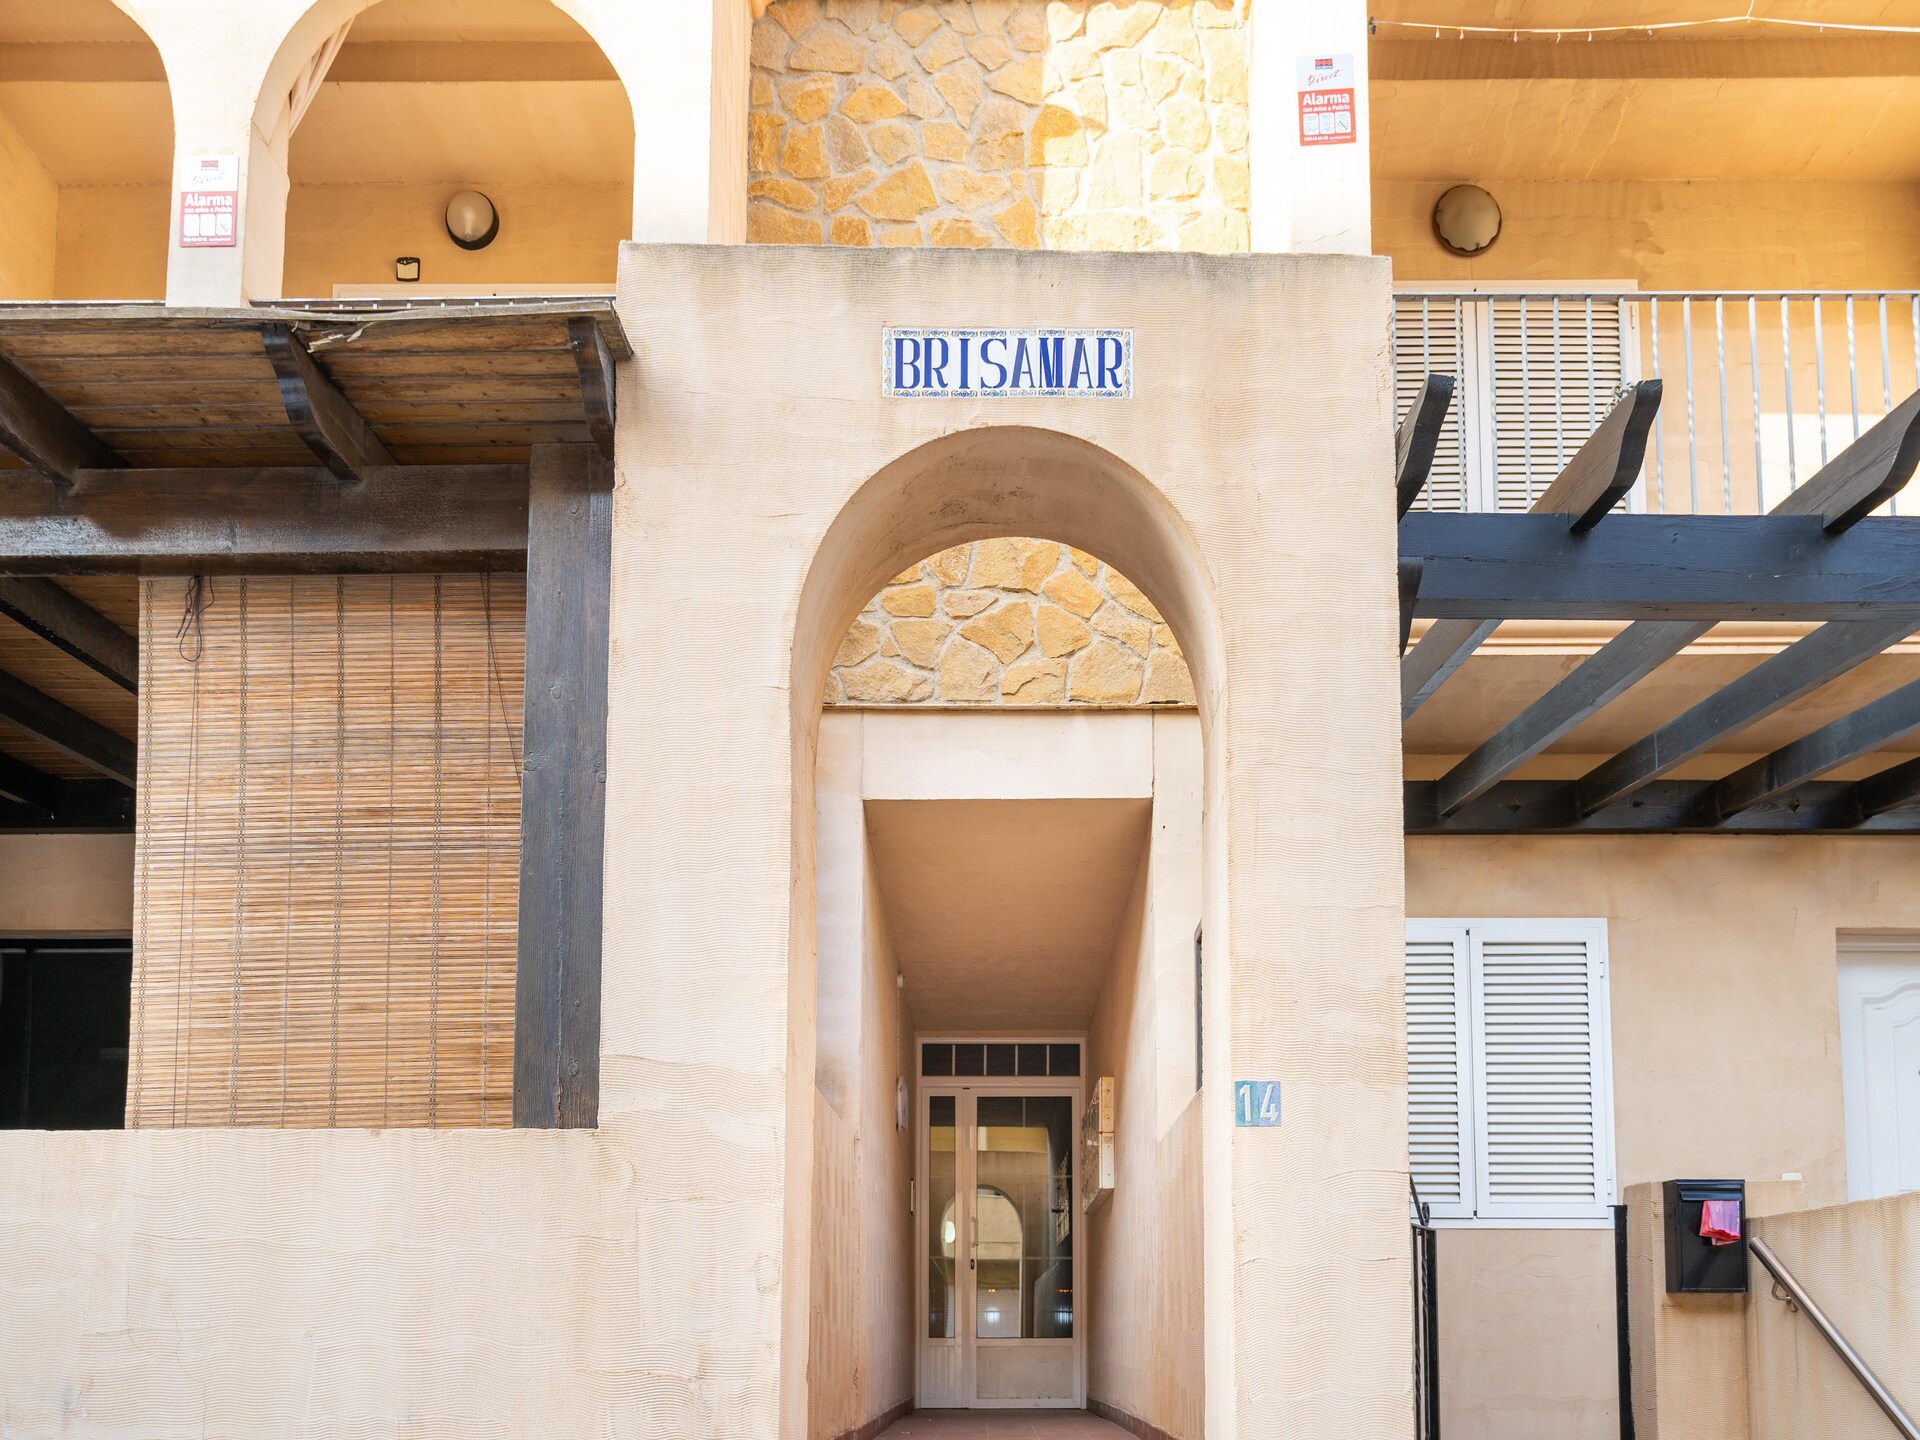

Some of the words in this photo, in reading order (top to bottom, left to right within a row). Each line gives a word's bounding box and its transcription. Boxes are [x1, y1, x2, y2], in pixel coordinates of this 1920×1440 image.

[1302, 92, 1350, 106] Alarma
[184, 193, 233, 206] Alarma
[893, 337, 1123, 389] BRISAMAR
[1239, 1084, 1279, 1122] 14
